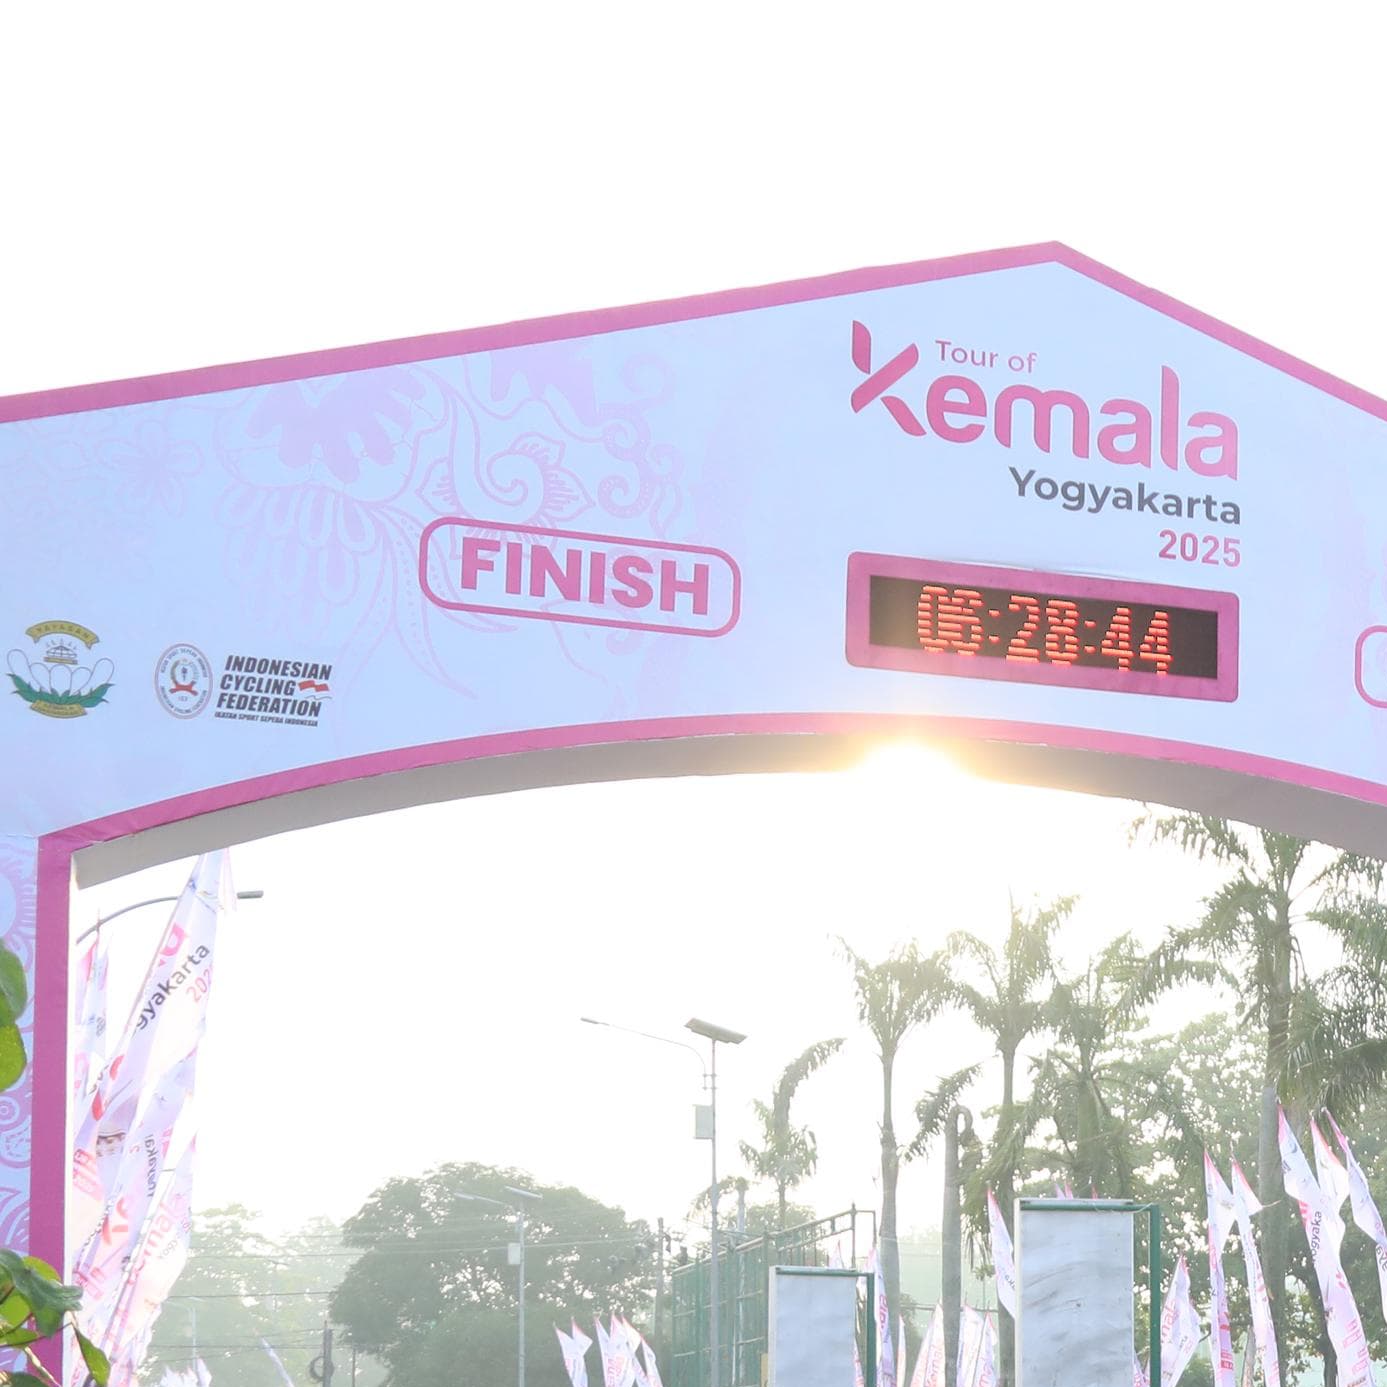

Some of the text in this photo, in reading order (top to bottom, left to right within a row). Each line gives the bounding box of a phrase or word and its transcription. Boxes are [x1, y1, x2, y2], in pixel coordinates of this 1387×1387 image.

[936, 340, 1037, 374] Tour of
[851, 320, 1238, 481] Kemala
[1009, 466, 1241, 525] Yogyakarta
[1158, 529, 1241, 567] 2025
[461, 537, 709, 615] FINISH
[220, 674, 296, 695] CYCLING
[225, 655, 332, 679] INDONESIAN
[217, 693, 321, 717] FEDERATION
